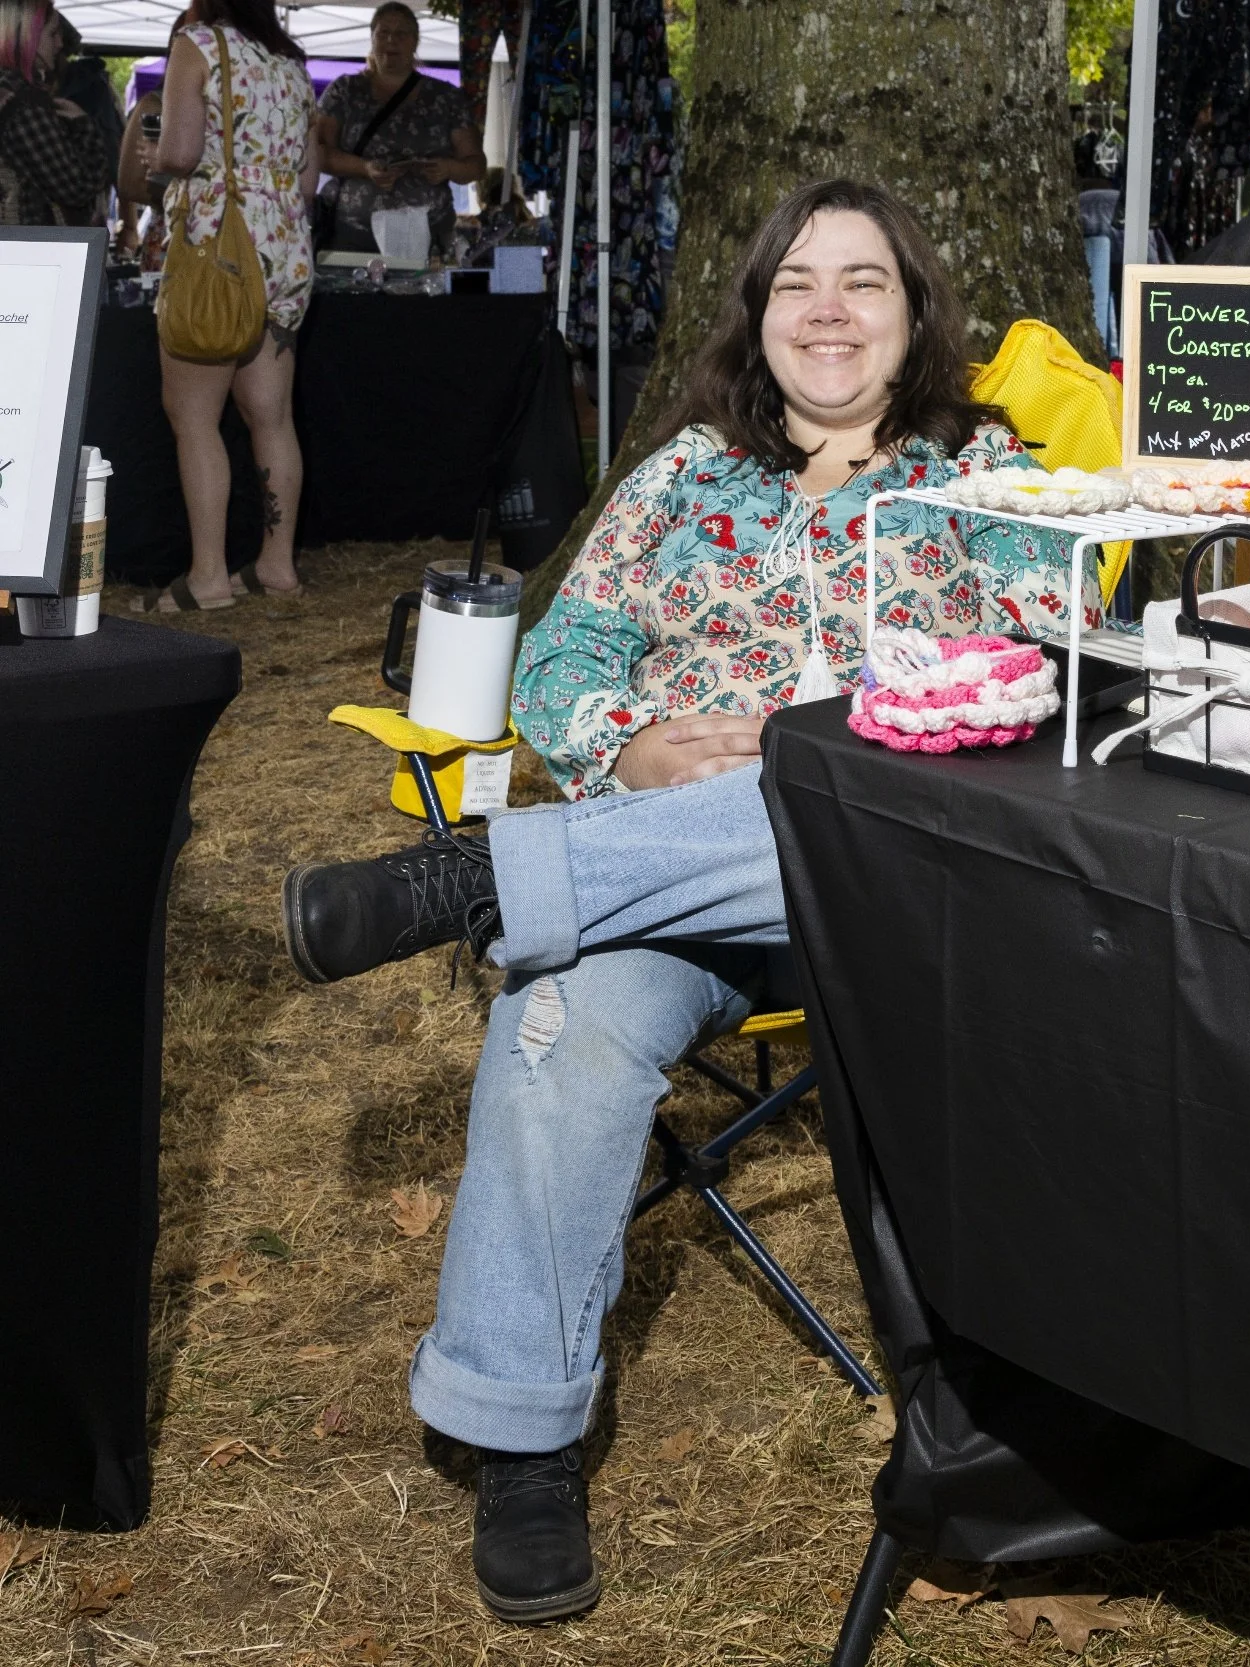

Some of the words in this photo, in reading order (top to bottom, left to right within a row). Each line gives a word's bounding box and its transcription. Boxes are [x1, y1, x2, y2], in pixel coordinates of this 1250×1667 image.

[1149, 290, 1250, 324] FLOWER
[1186, 376, 1208, 386] EA.
[1148, 391, 1163, 413] 4
[1167, 400, 1193, 414] FOR
[1147, 430, 1182, 454] MIX
[1188, 430, 1211, 449] AND
